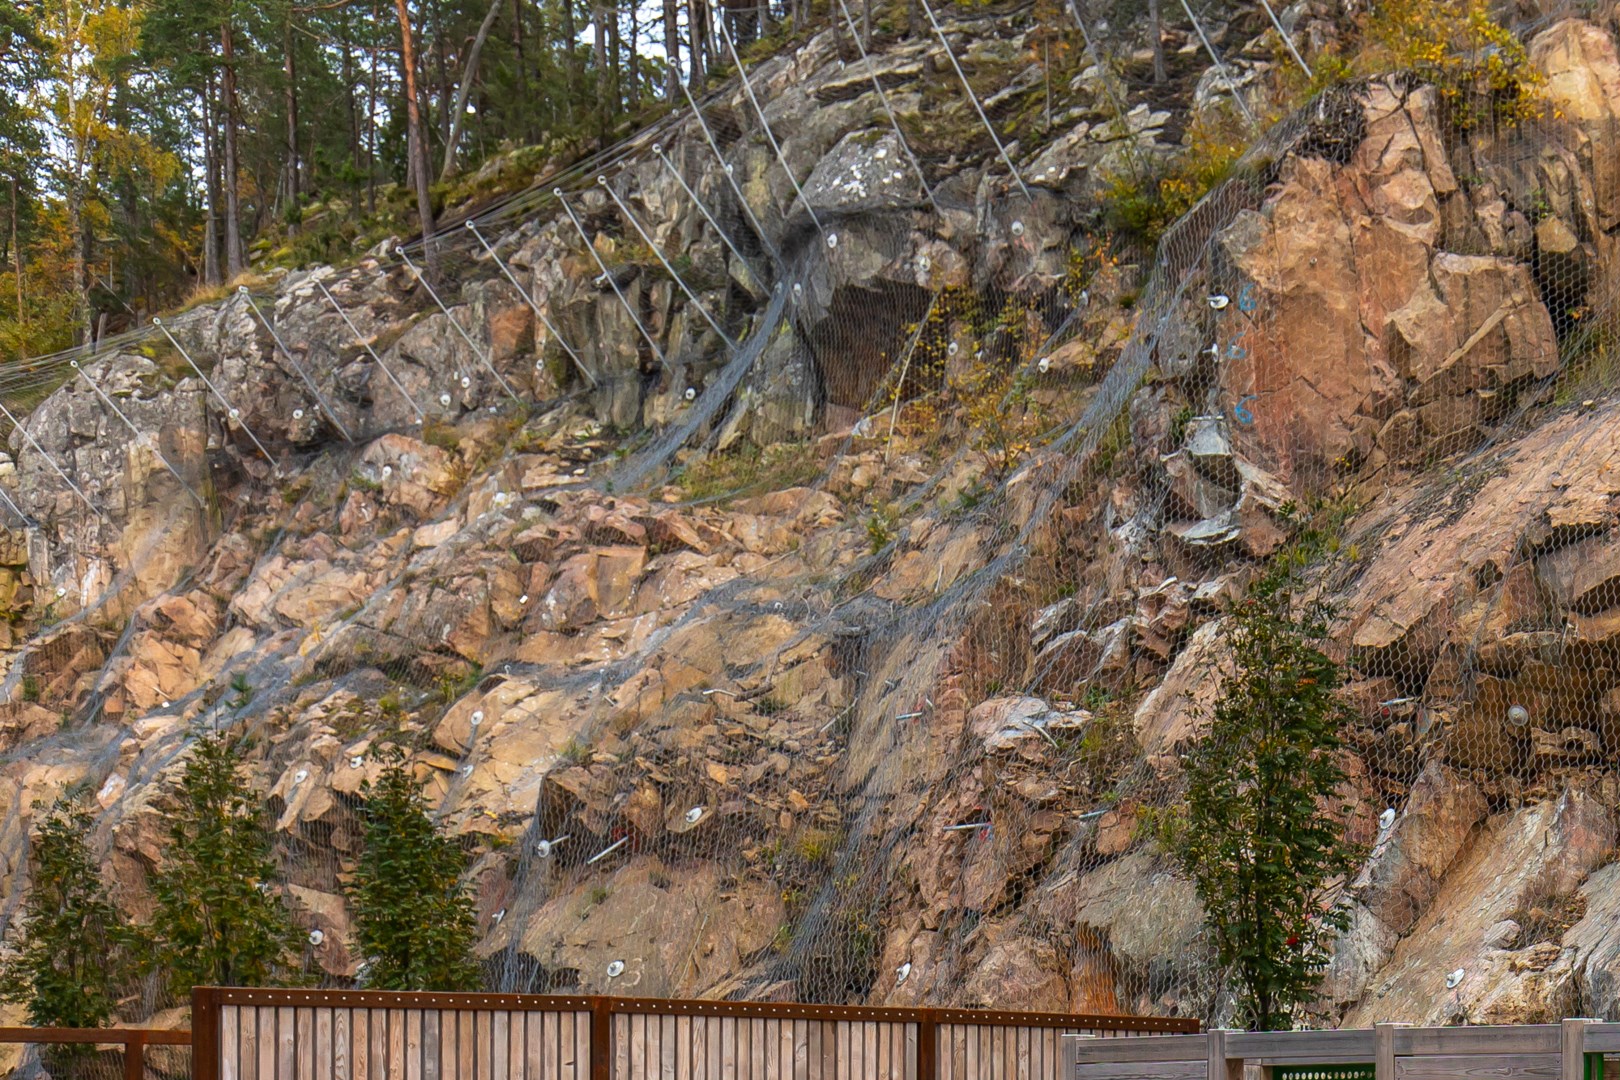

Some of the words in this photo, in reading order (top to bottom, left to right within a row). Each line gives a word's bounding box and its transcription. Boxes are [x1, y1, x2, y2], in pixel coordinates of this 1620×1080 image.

[1239, 283, 1257, 311] 6
[1226, 332, 1246, 359] 6
[1234, 395, 1257, 424] 6
